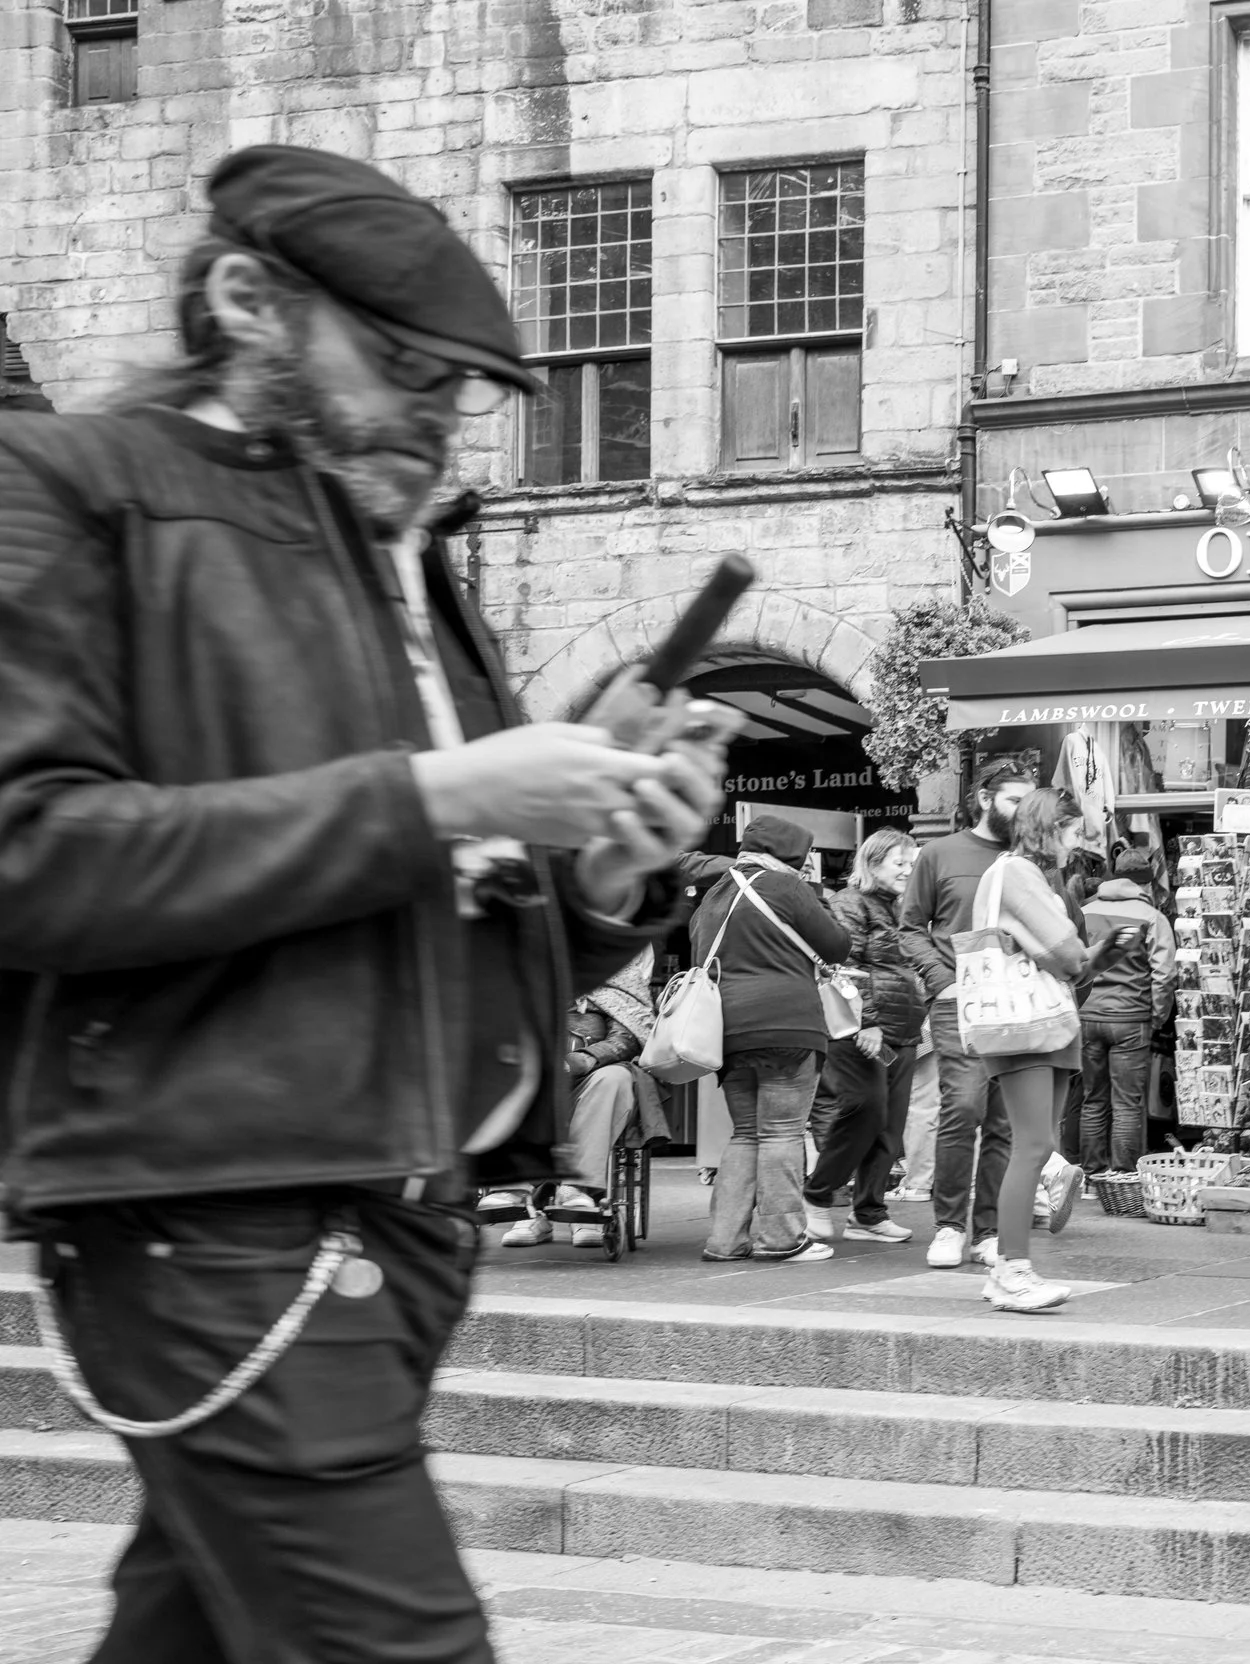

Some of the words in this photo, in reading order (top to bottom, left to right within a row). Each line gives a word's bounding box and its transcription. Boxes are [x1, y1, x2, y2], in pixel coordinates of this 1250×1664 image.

[999, 702, 1149, 724] LAMBSWOOL
[812, 765, 873, 789] Land
[884, 804, 915, 817] 1501
